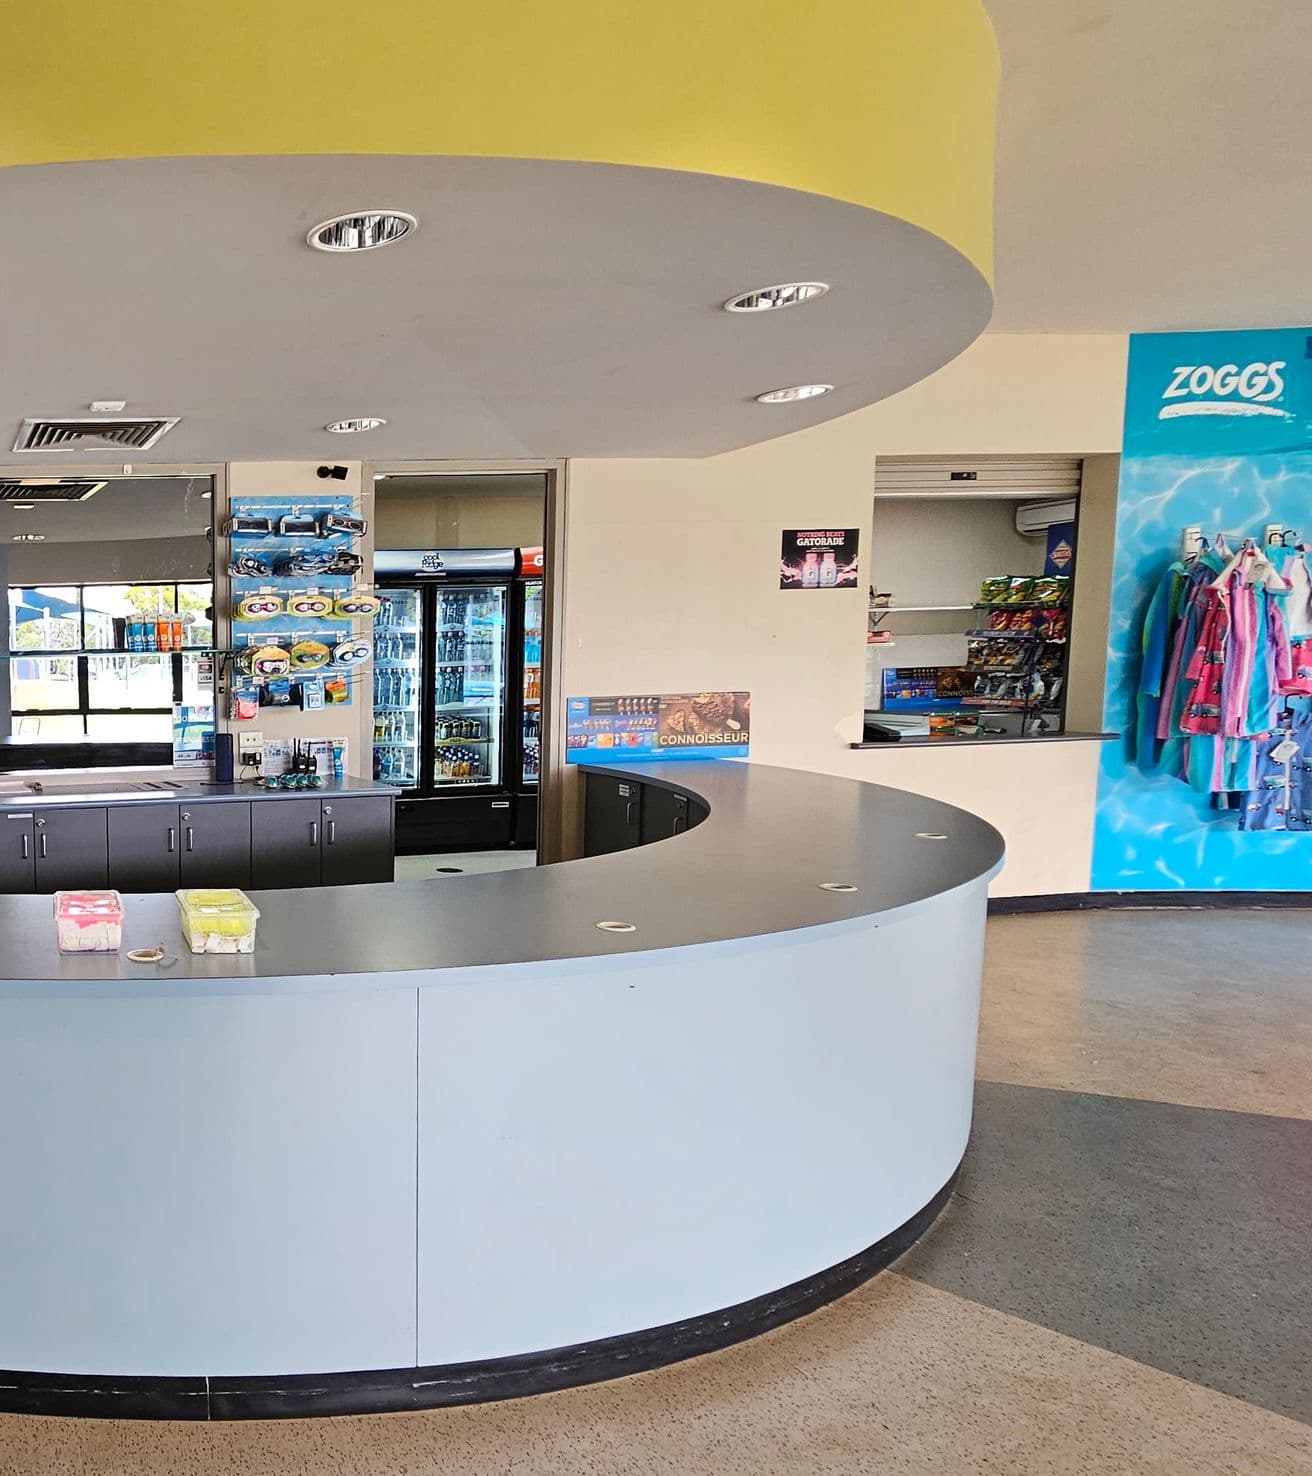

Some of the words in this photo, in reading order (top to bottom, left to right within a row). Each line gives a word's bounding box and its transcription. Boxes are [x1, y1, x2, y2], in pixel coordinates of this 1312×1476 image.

[1161, 361, 1287, 402] ZOGGS
[796, 537, 845, 546] GATORADE
[660, 732, 749, 745] CONNOISSEUR
